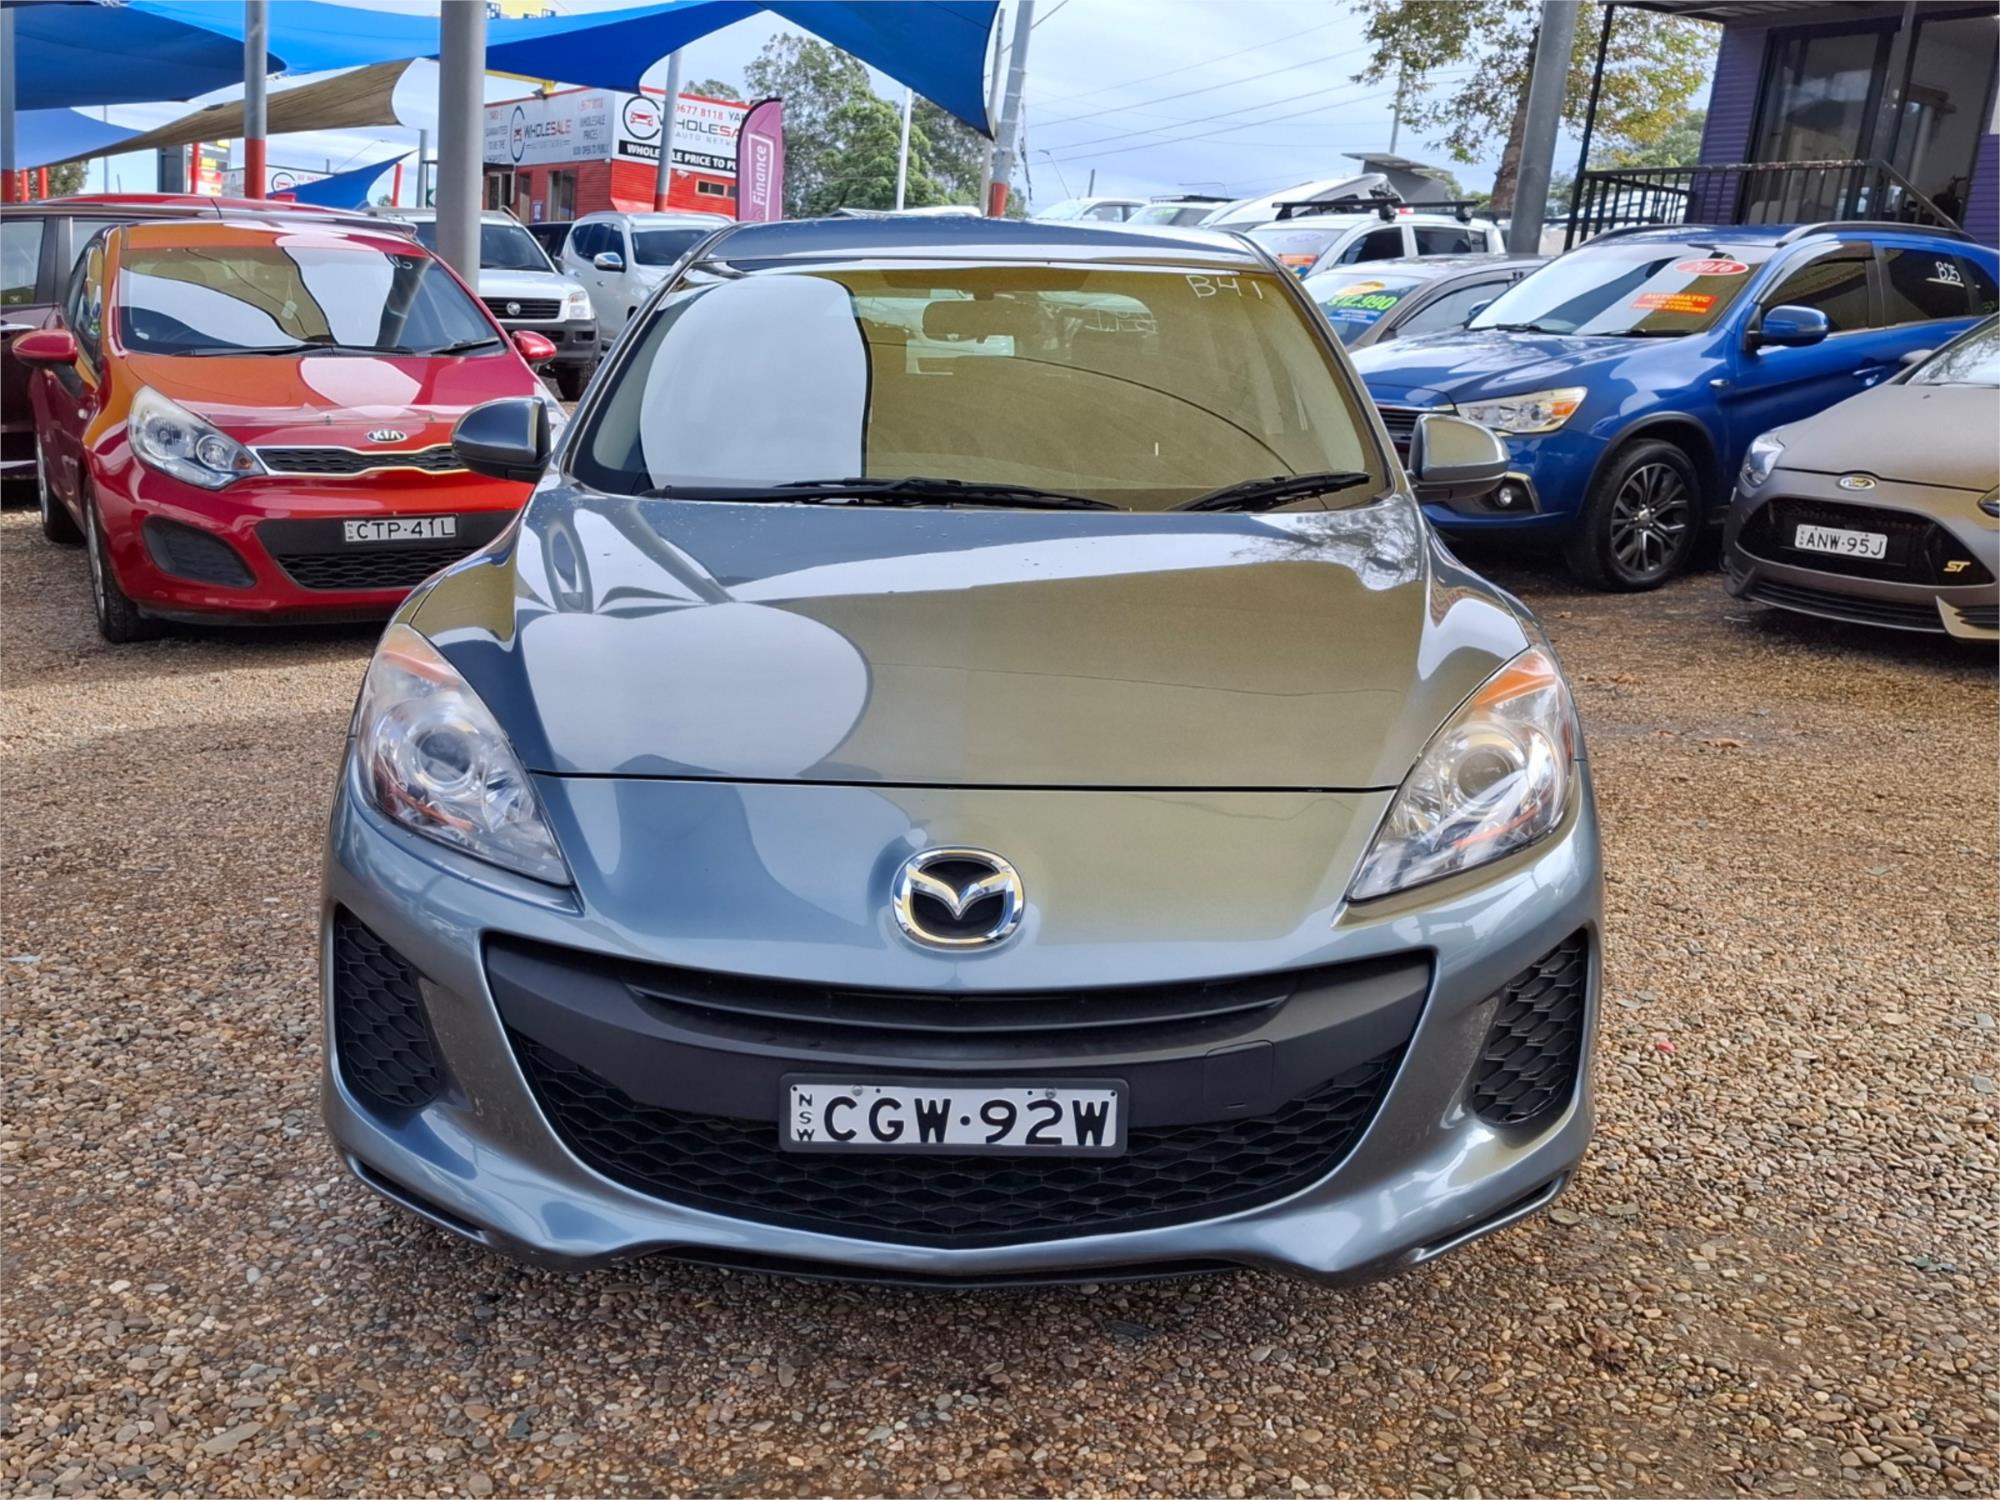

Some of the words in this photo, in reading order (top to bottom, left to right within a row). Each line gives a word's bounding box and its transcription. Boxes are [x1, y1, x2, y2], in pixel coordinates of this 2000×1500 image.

[525, 120, 572, 138] WHOLESALE
[627, 143, 684, 162] WHOLELE
[684, 154, 711, 169] PRICE
[713, 157, 725, 169] TO
[752, 145, 767, 206] Finance
[1185, 275, 1263, 300] B41
[372, 430, 401, 440] KIA
[1943, 560, 1971, 572] ST
[796, 1093, 815, 1142] NSW
